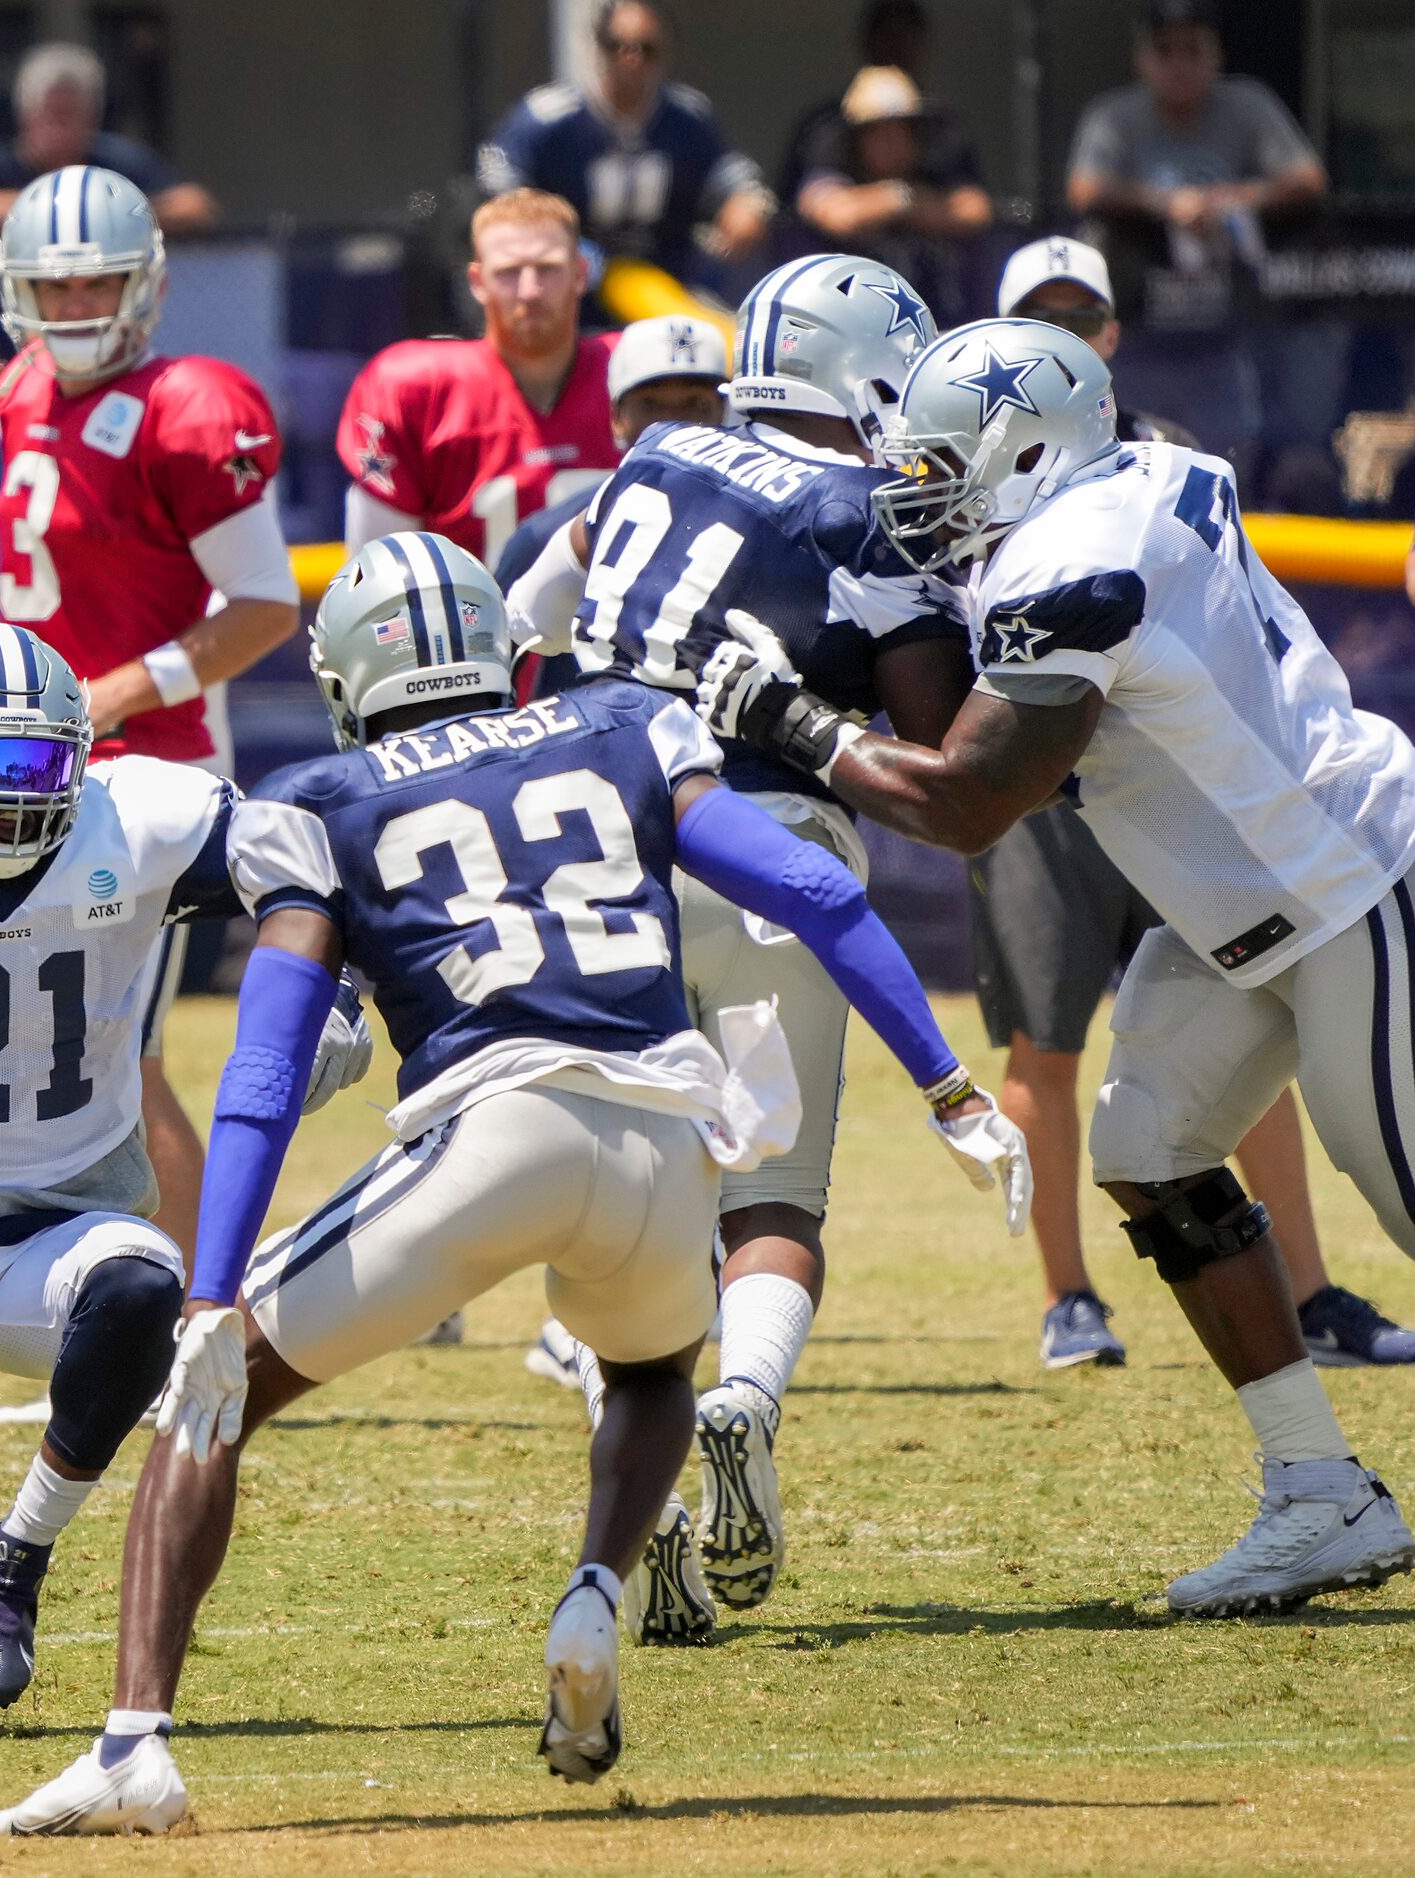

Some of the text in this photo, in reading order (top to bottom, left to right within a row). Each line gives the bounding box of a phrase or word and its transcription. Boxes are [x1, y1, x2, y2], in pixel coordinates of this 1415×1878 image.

[406, 672, 482, 695] COWBOYS
[365, 696, 579, 782] KEARSE
[87, 902, 123, 919] AT&T
[373, 767, 672, 1007] 32
